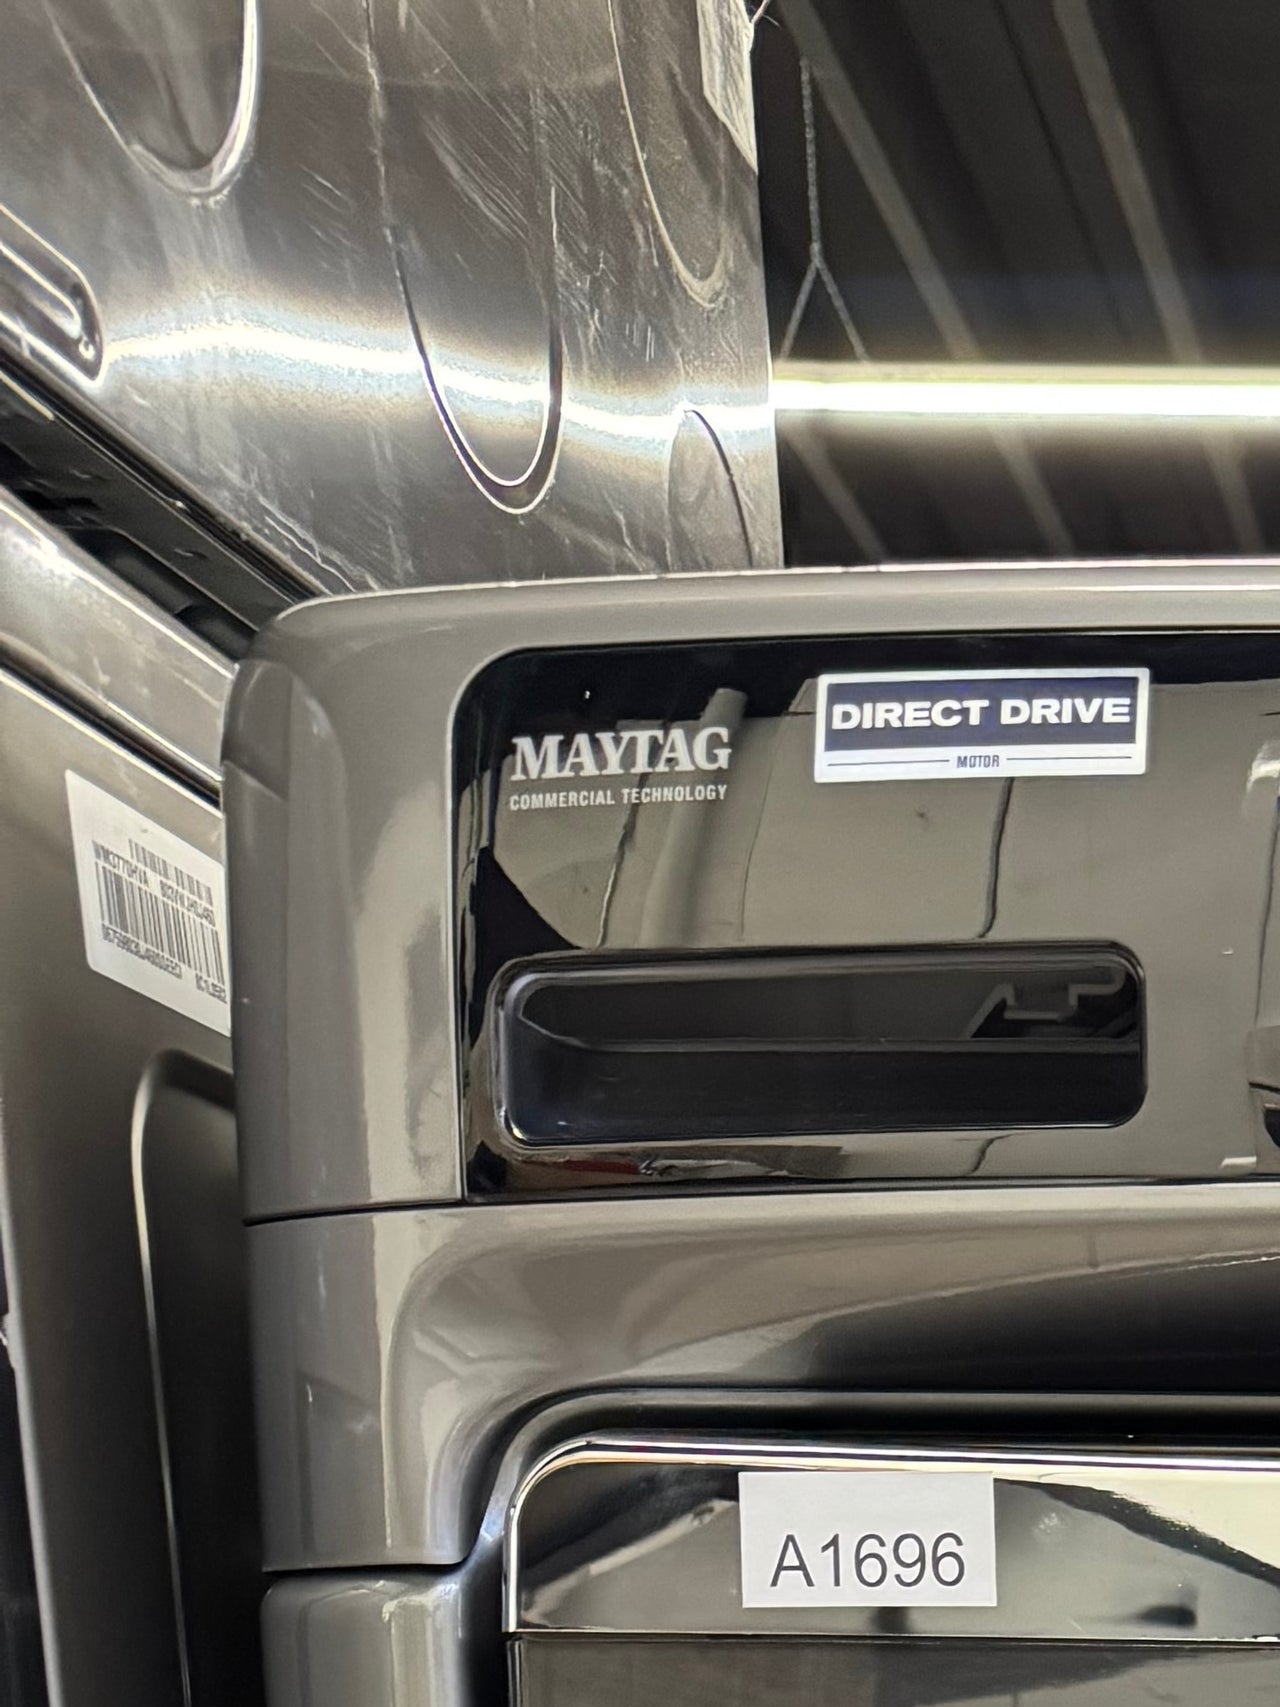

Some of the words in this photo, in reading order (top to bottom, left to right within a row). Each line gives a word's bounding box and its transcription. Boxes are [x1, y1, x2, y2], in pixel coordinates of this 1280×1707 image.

[829, 698, 991, 731] DIRECT
[1000, 695, 1132, 726] DRIVE
[510, 726, 733, 781] MAYTAG
[955, 751, 1001, 770] MOTOR
[508, 786, 617, 812] COMMERCIAL
[621, 782, 729, 806] TECHNOLOGY
[769, 1530, 966, 1589] A1696
